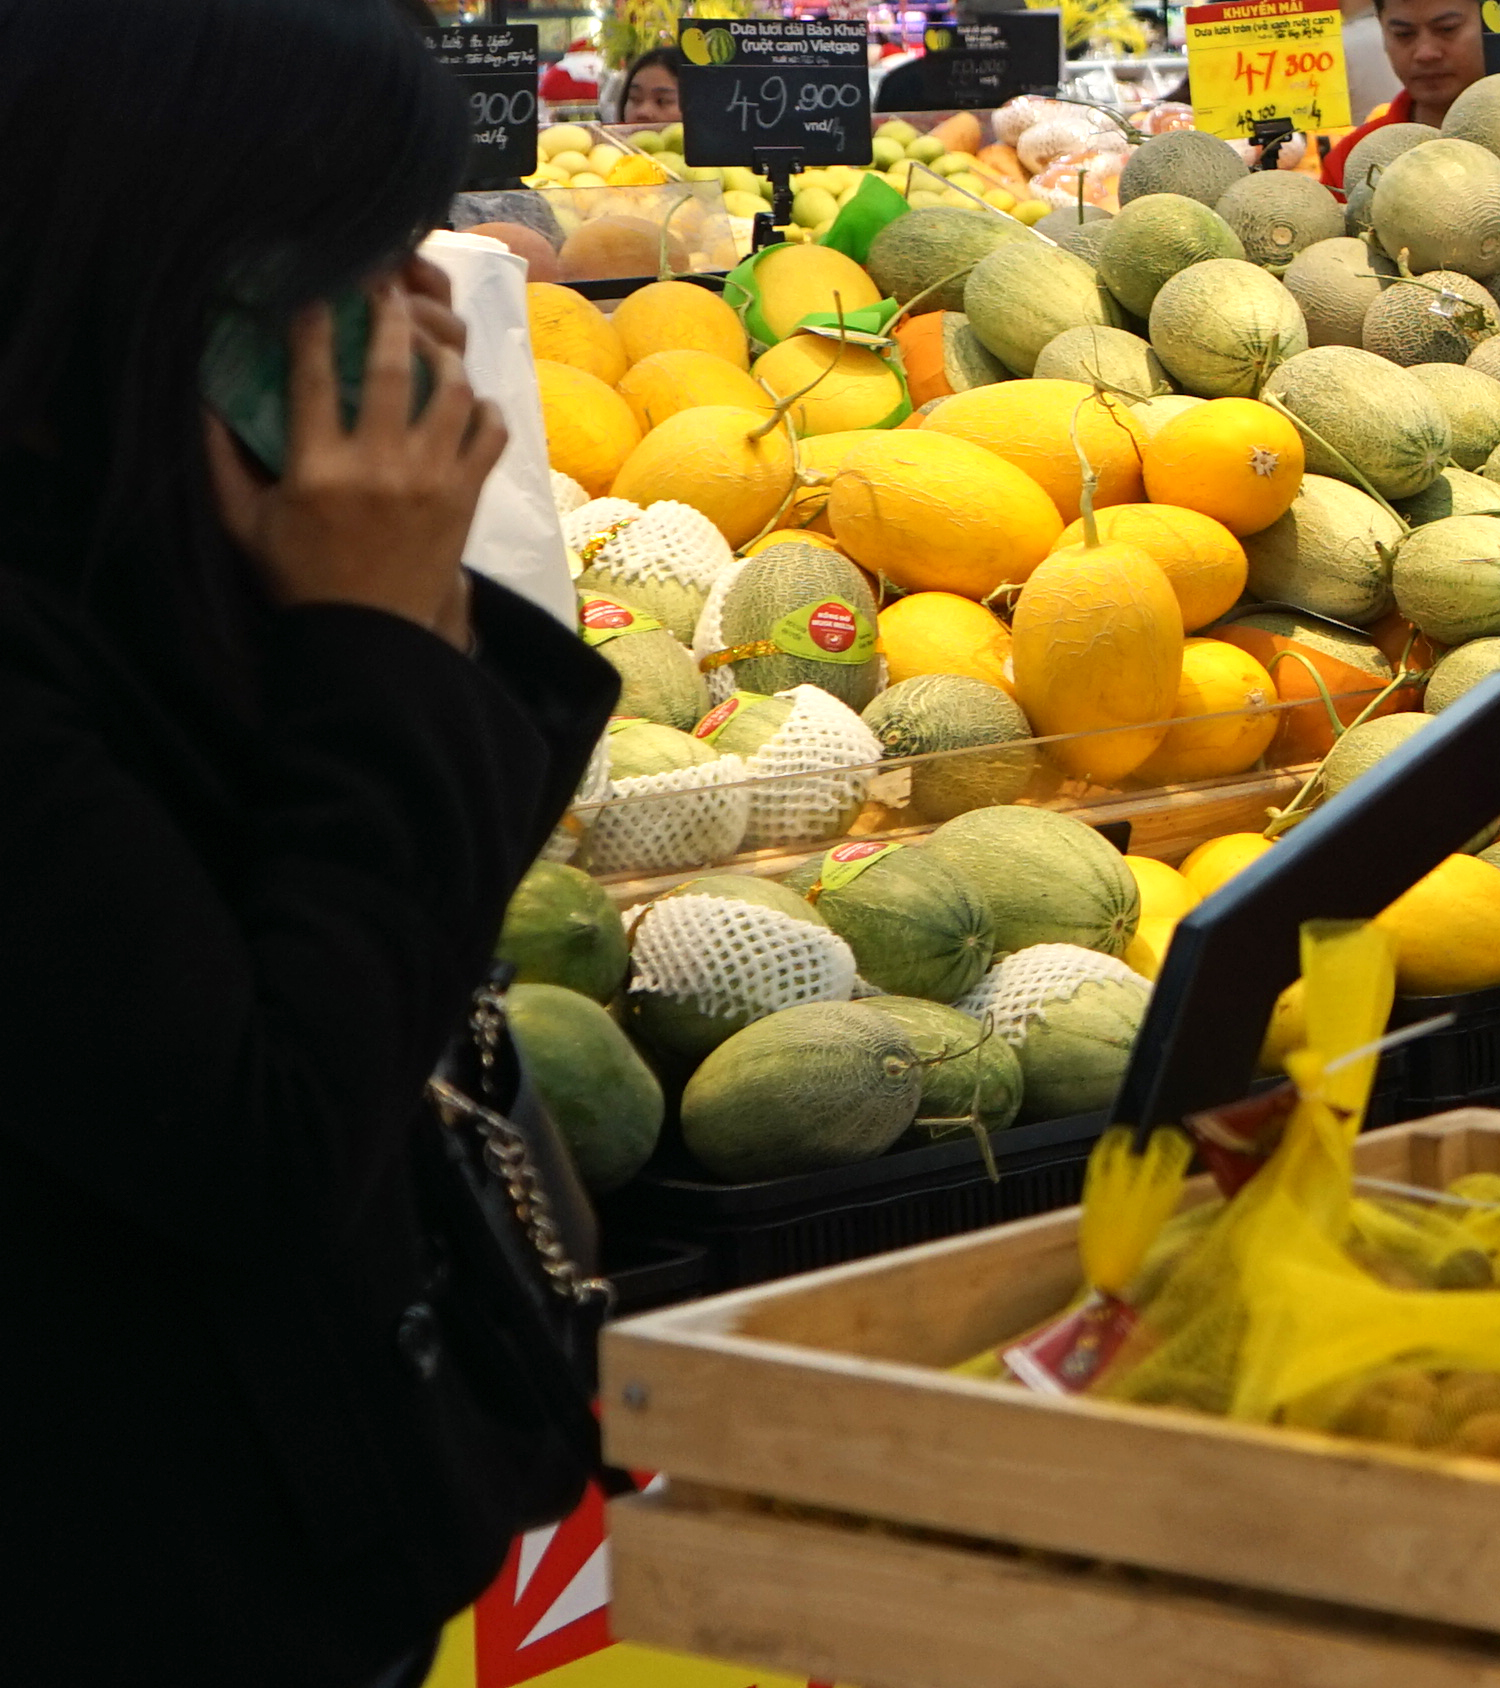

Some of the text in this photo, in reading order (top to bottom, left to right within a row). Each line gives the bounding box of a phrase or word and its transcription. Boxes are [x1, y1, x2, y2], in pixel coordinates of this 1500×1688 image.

[1223, 0, 1304, 19] KHUYẾN MÃI
[730, 22, 757, 36] Dưa
[759, 22, 782, 35] lưới
[742, 39, 860, 56] (ruột cam) Vietgap
[726, 76, 861, 131] 49.900
